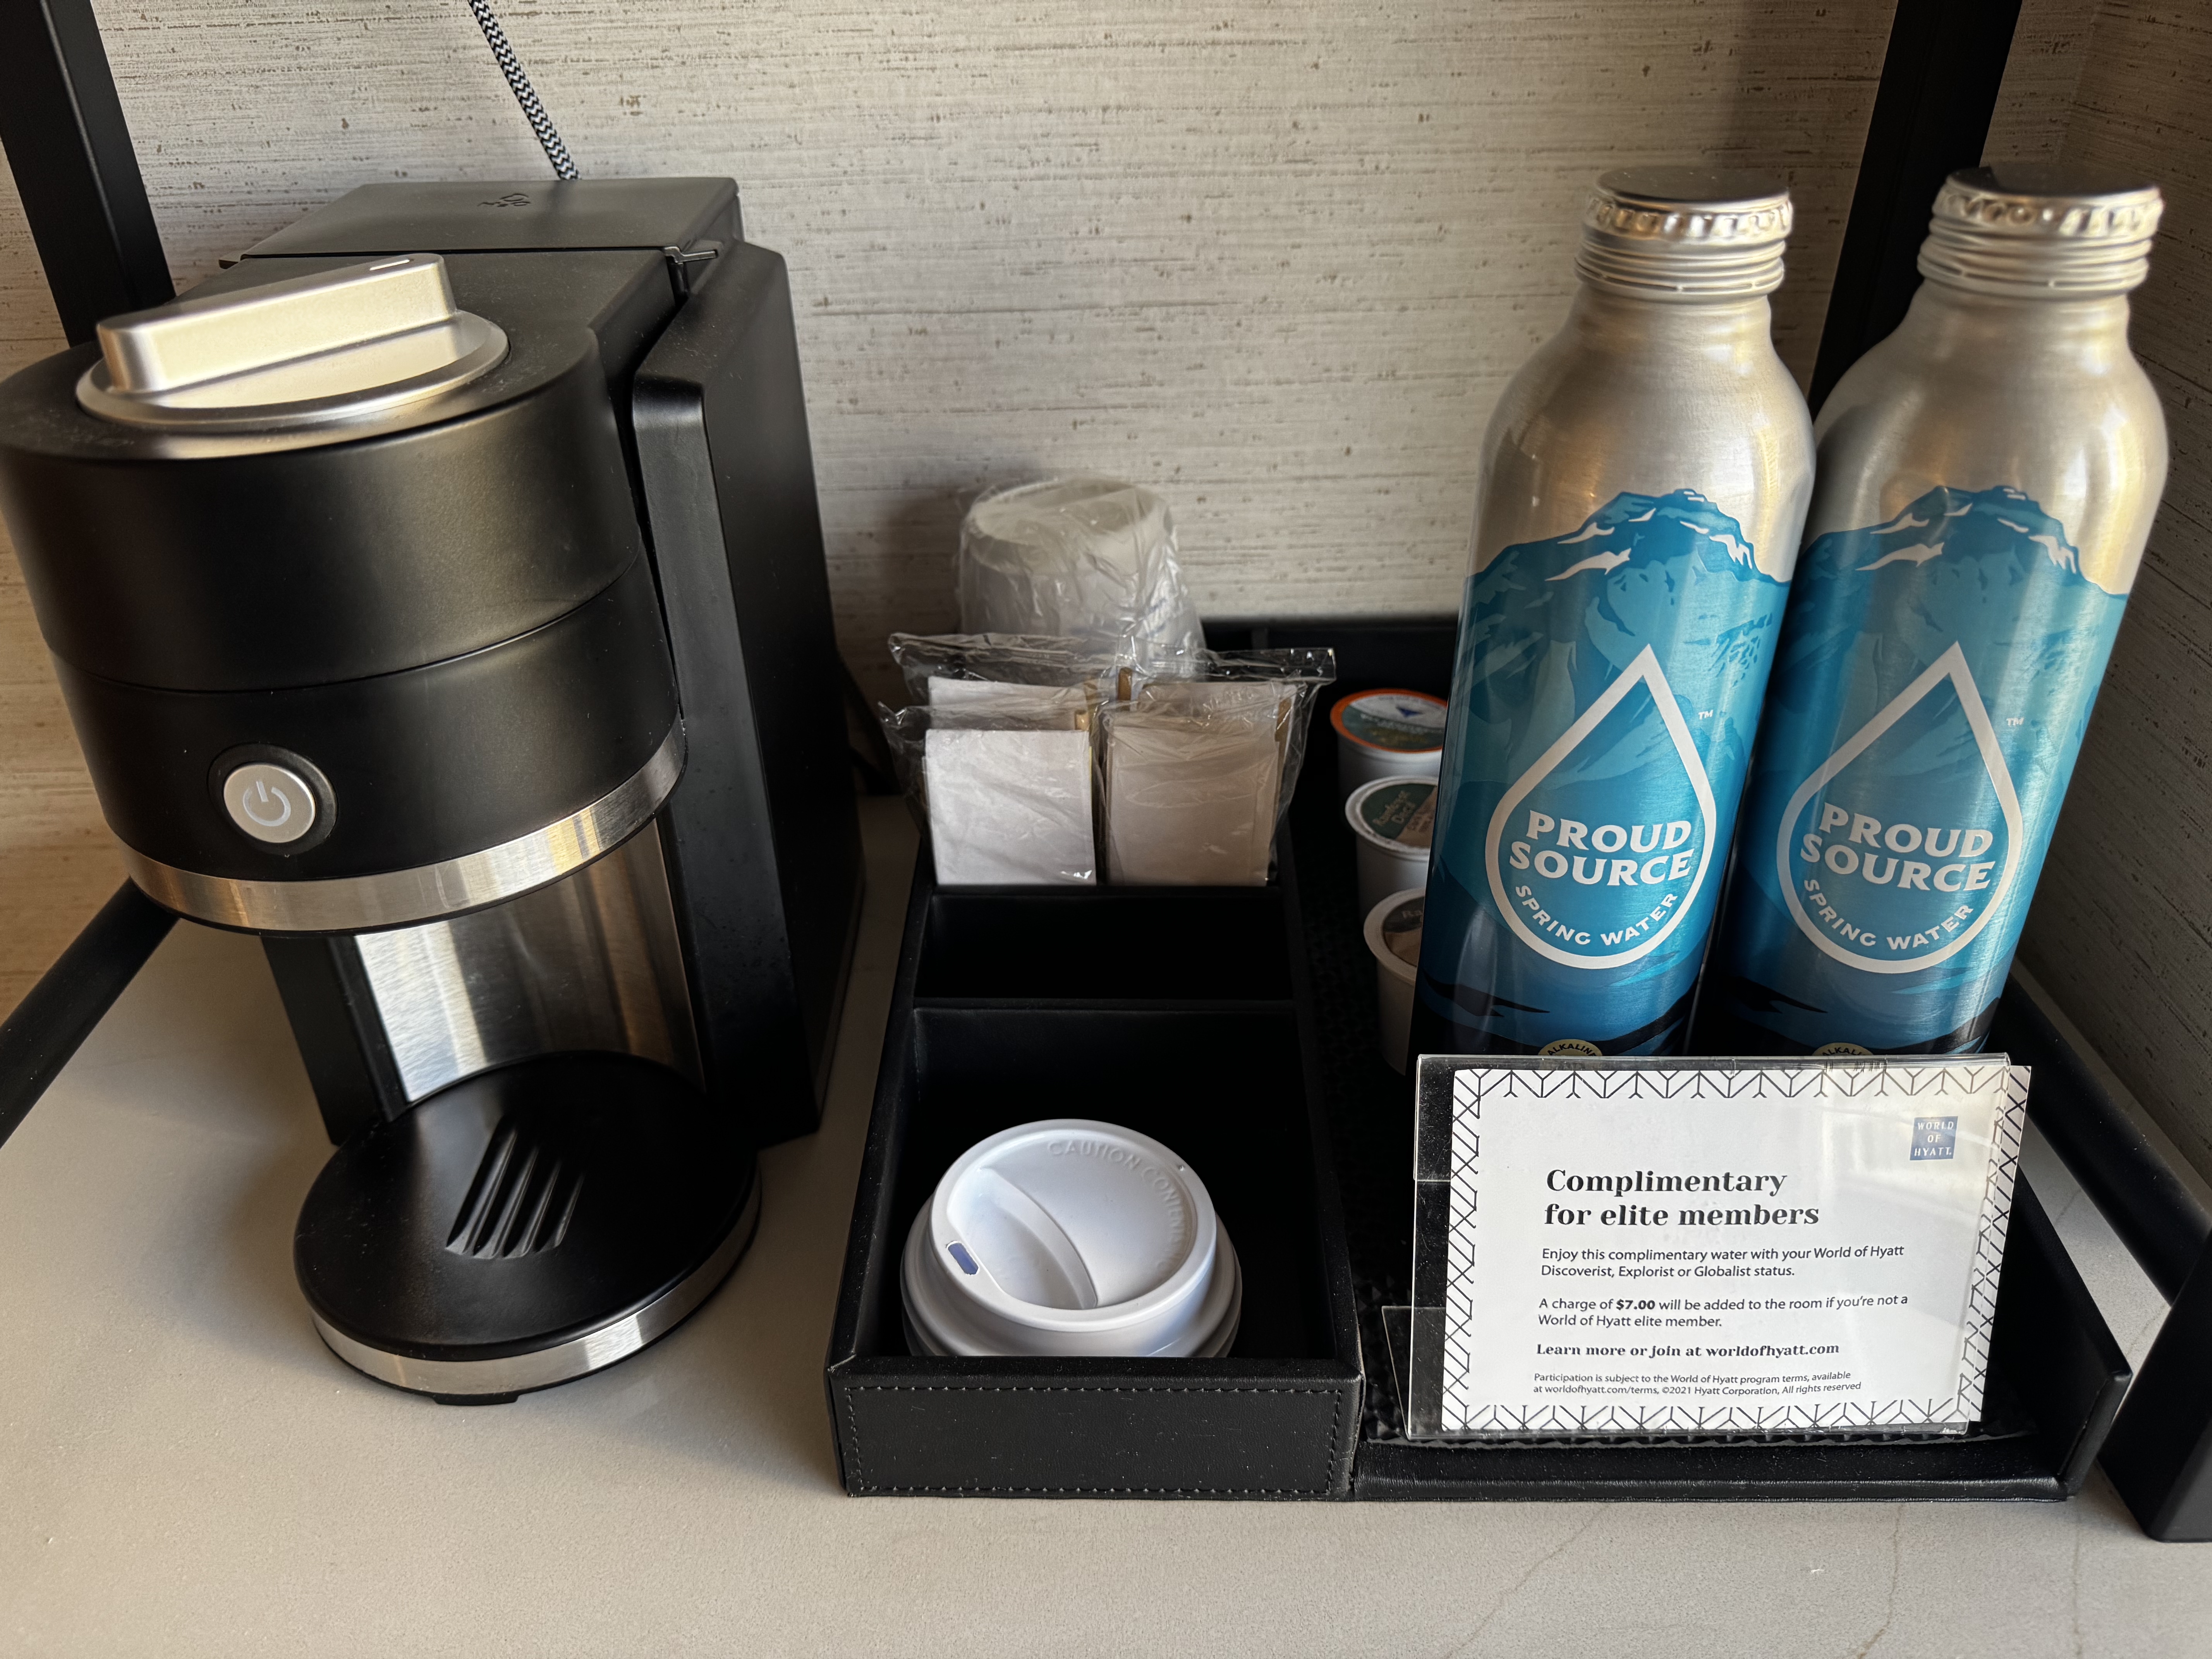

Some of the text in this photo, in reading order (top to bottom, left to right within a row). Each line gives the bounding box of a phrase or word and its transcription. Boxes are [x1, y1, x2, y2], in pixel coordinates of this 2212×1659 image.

[1526, 810, 1691, 852] PROUD
[1818, 802, 1994, 859] PROUD
[1509, 841, 1695, 886] SOURCE
[1800, 834, 1996, 891] SOURCE
[1515, 885, 1678, 946] SPRING WATER
[1804, 878, 1973, 950] SPRING WATER
[1918, 1121, 1954, 1130] WORLD
[1927, 1134, 1942, 1143] OF
[1048, 1140, 1141, 1170] CAUTION
[1547, 1169, 1788, 1197] Complimentary
[1544, 1203, 1819, 1226] for elite members
[1542, 1245, 1905, 1263] Enjoy this complimentary water with your World of Hyatt
[1541, 1265, 1795, 1279] Discoverist, Explorist or Globalist status.
[1539, 1298, 1548, 1309] A
[1552, 1298, 1597, 1312] charge
[1599, 1298, 1614, 1310] of
[1616, 1298, 1656, 1311] $7.00
[1659, 1299, 1681, 1310] will
[1684, 1299, 1701, 1310] be
[1704, 1298, 1745, 1310] added
[1748, 1300, 1761, 1310] to
[1764, 1298, 1786, 1310] the
[1789, 1300, 1822, 1309] room
[1826, 1297, 1836, 1308] if
[1877, 1295, 1899, 1305] not
[1901, 1296, 1908, 1304] a
[1538, 1314, 1722, 1329] World of Hyatt elite member.
[1537, 1343, 1839, 1359] Learn more or join at worldofhyatt.com
[1534, 1373, 1593, 1383] Participation
[1595, 1374, 1602, 1382] is
[1604, 1374, 1639, 1384] subject
[1653, 1374, 1669, 1382] the
[1670, 1374, 1698, 1383] World
[1700, 1375, 1711, 1383] of
[1712, 1375, 1739, 1385] Hyatt
[1740, 1377, 1780, 1386] program
[1812, 1371, 1851, 1381] available
[1544, 1384, 1659, 1395] worldofhyatt.com/terms,
[1694, 1386, 1721, 1396] Hyatt
[1722, 1387, 1780, 1396] Corporation,
[1781, 1385, 1794, 1394] All
[1796, 1384, 1821, 1395] rights
[1823, 1381, 1862, 1391] reserved
